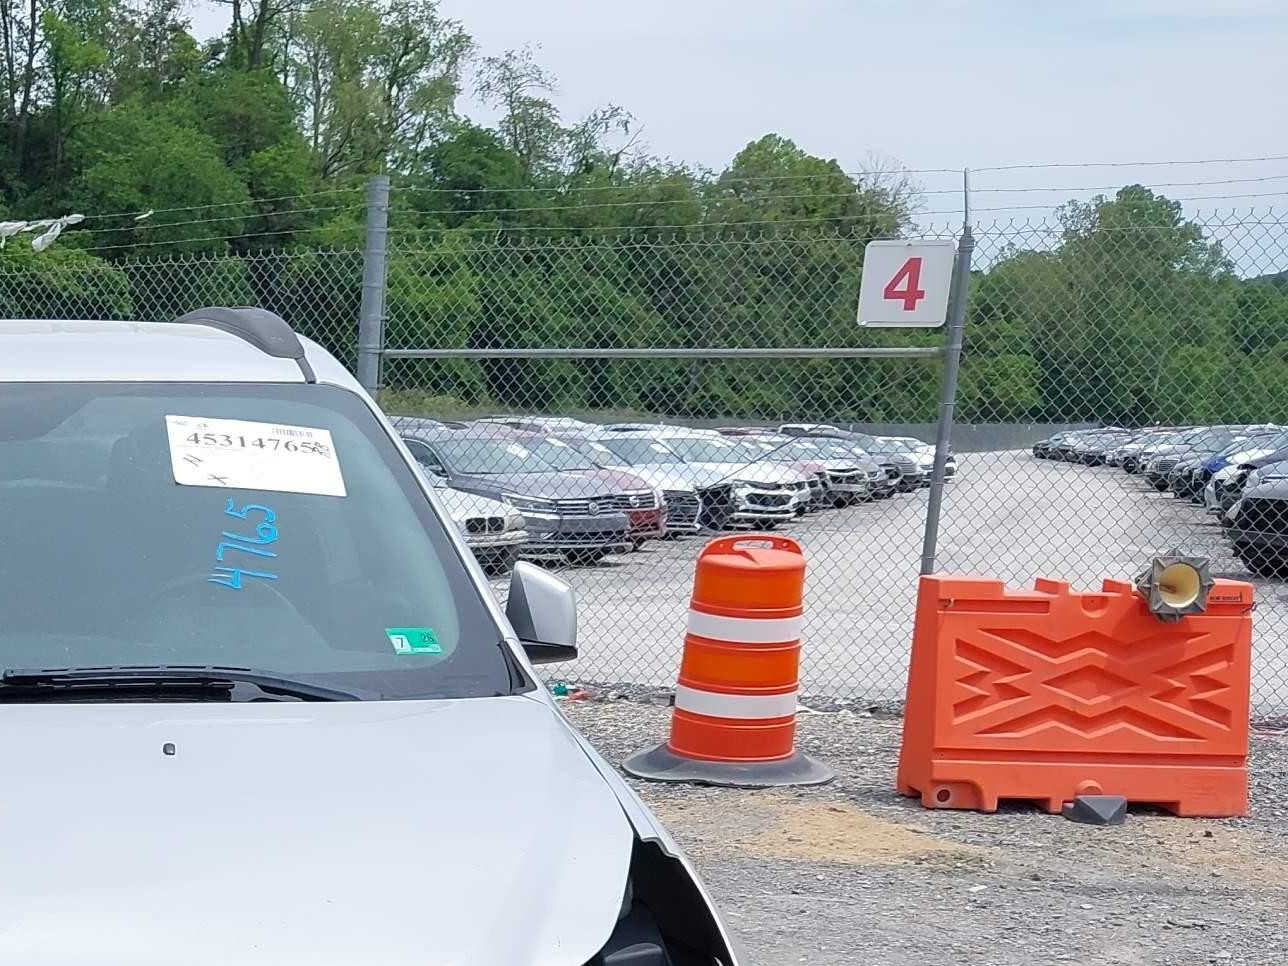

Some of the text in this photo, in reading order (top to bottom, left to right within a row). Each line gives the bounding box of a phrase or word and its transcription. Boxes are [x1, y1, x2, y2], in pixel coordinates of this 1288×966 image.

[883, 257, 925, 311] 4
[186, 432, 314, 454] 45314765
[208, 496, 279, 589] 4765
[394, 637, 404, 649] 7
